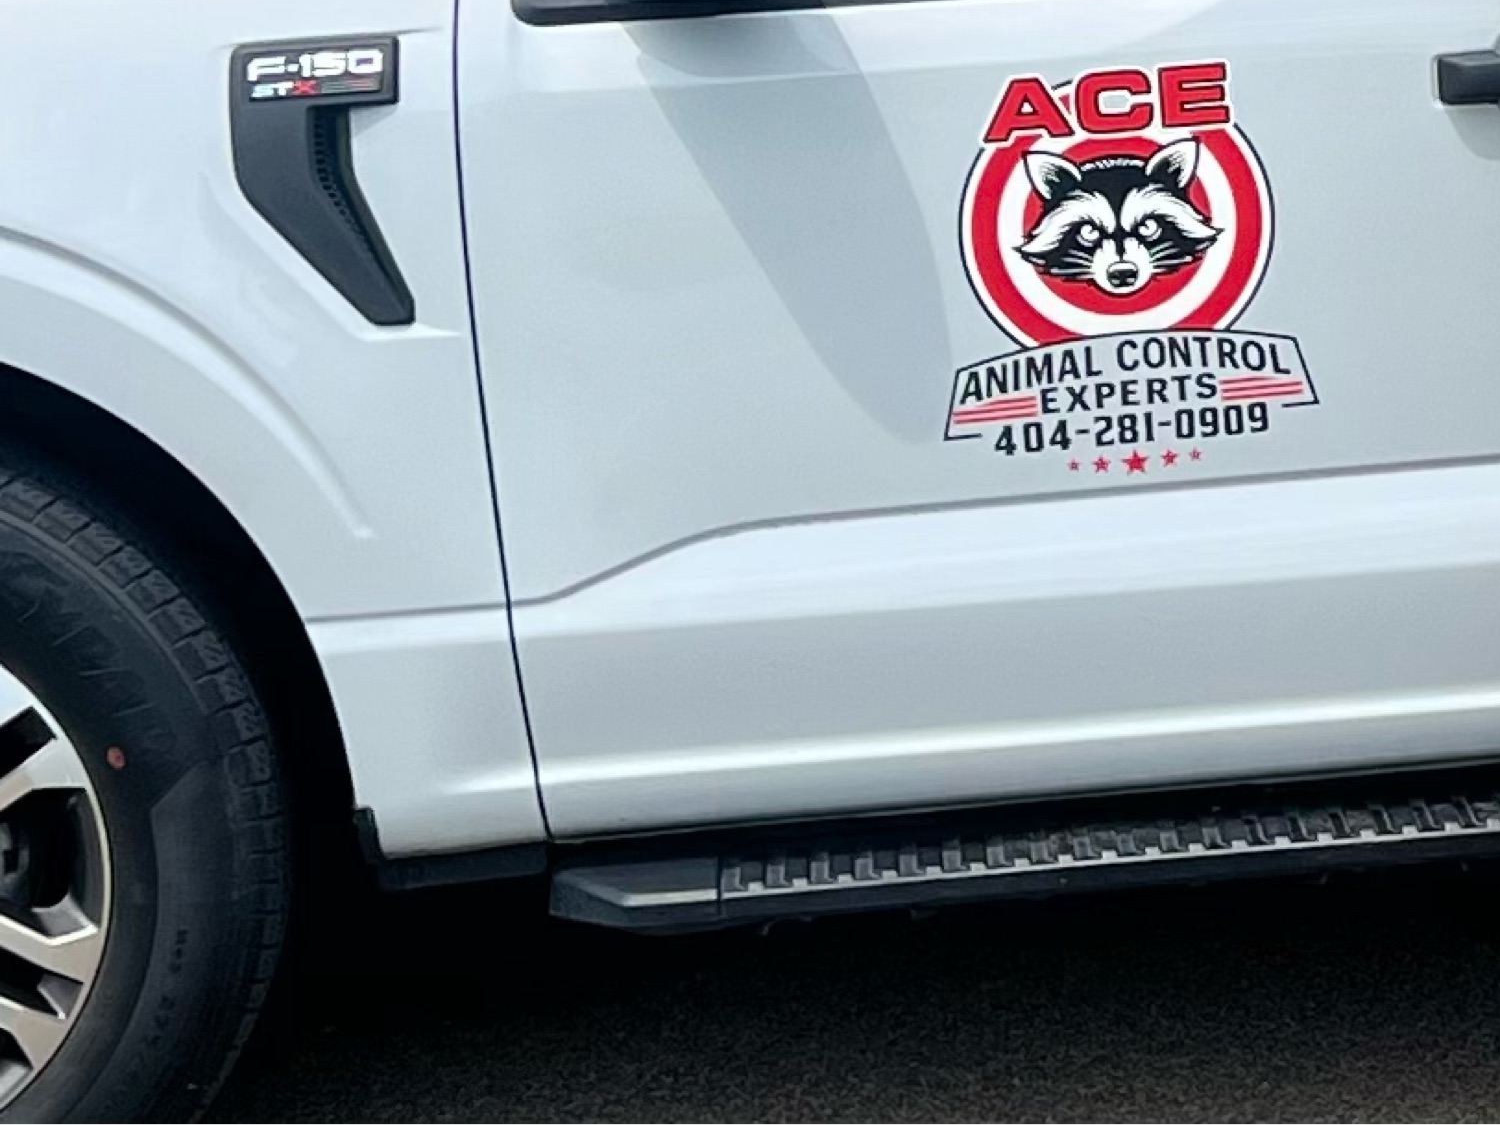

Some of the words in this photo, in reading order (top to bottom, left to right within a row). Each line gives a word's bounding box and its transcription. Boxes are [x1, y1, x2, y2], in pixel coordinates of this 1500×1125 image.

[247, 48, 384, 82] F-150
[251, 78, 319, 98] STX
[983, 62, 1230, 143] ACE
[958, 345, 1103, 405] ANIMAL
[1116, 336, 1292, 375] CONTROL
[1040, 372, 1218, 414] EXPERTS
[994, 401, 1270, 456] 404-281-0909
